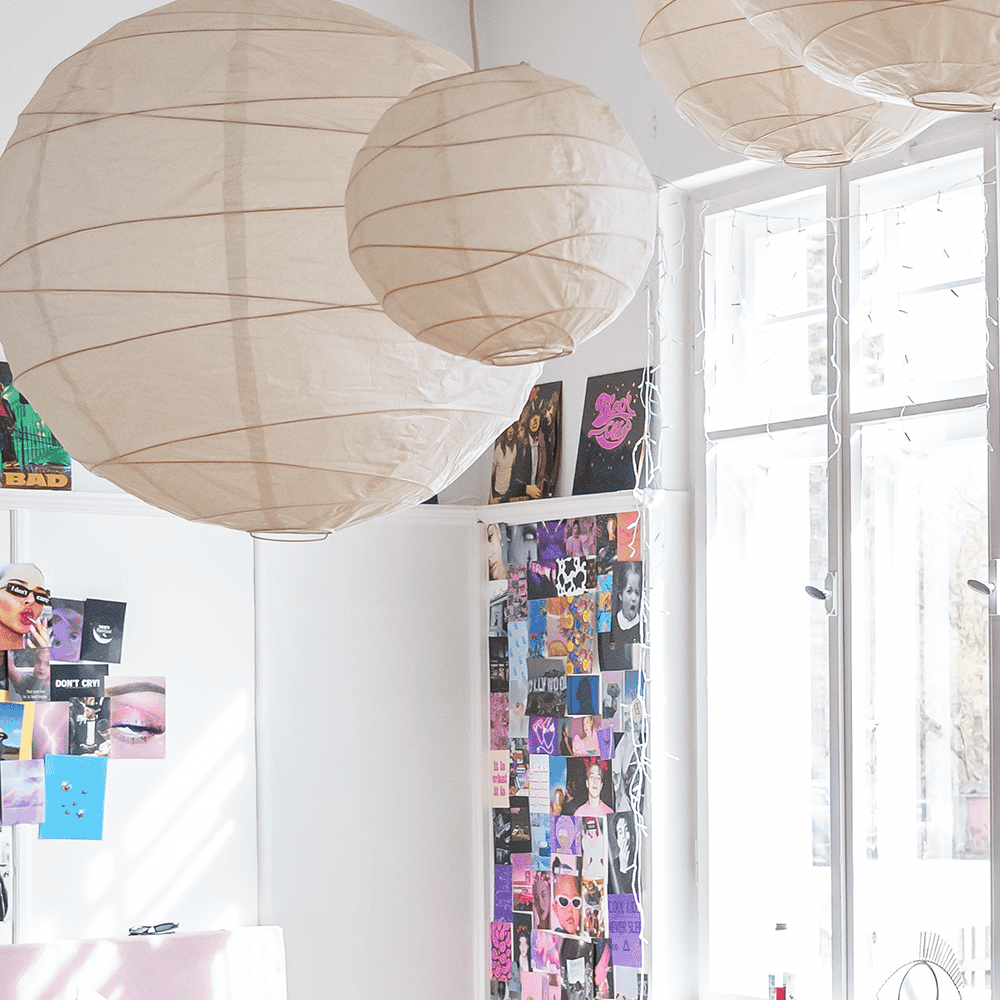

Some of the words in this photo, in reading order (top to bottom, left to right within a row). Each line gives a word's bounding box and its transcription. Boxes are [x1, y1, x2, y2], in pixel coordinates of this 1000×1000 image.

[4, 472, 69, 488] BAD
[55, 679, 80, 688] DON'T
[81, 679, 100, 688] CRY!
